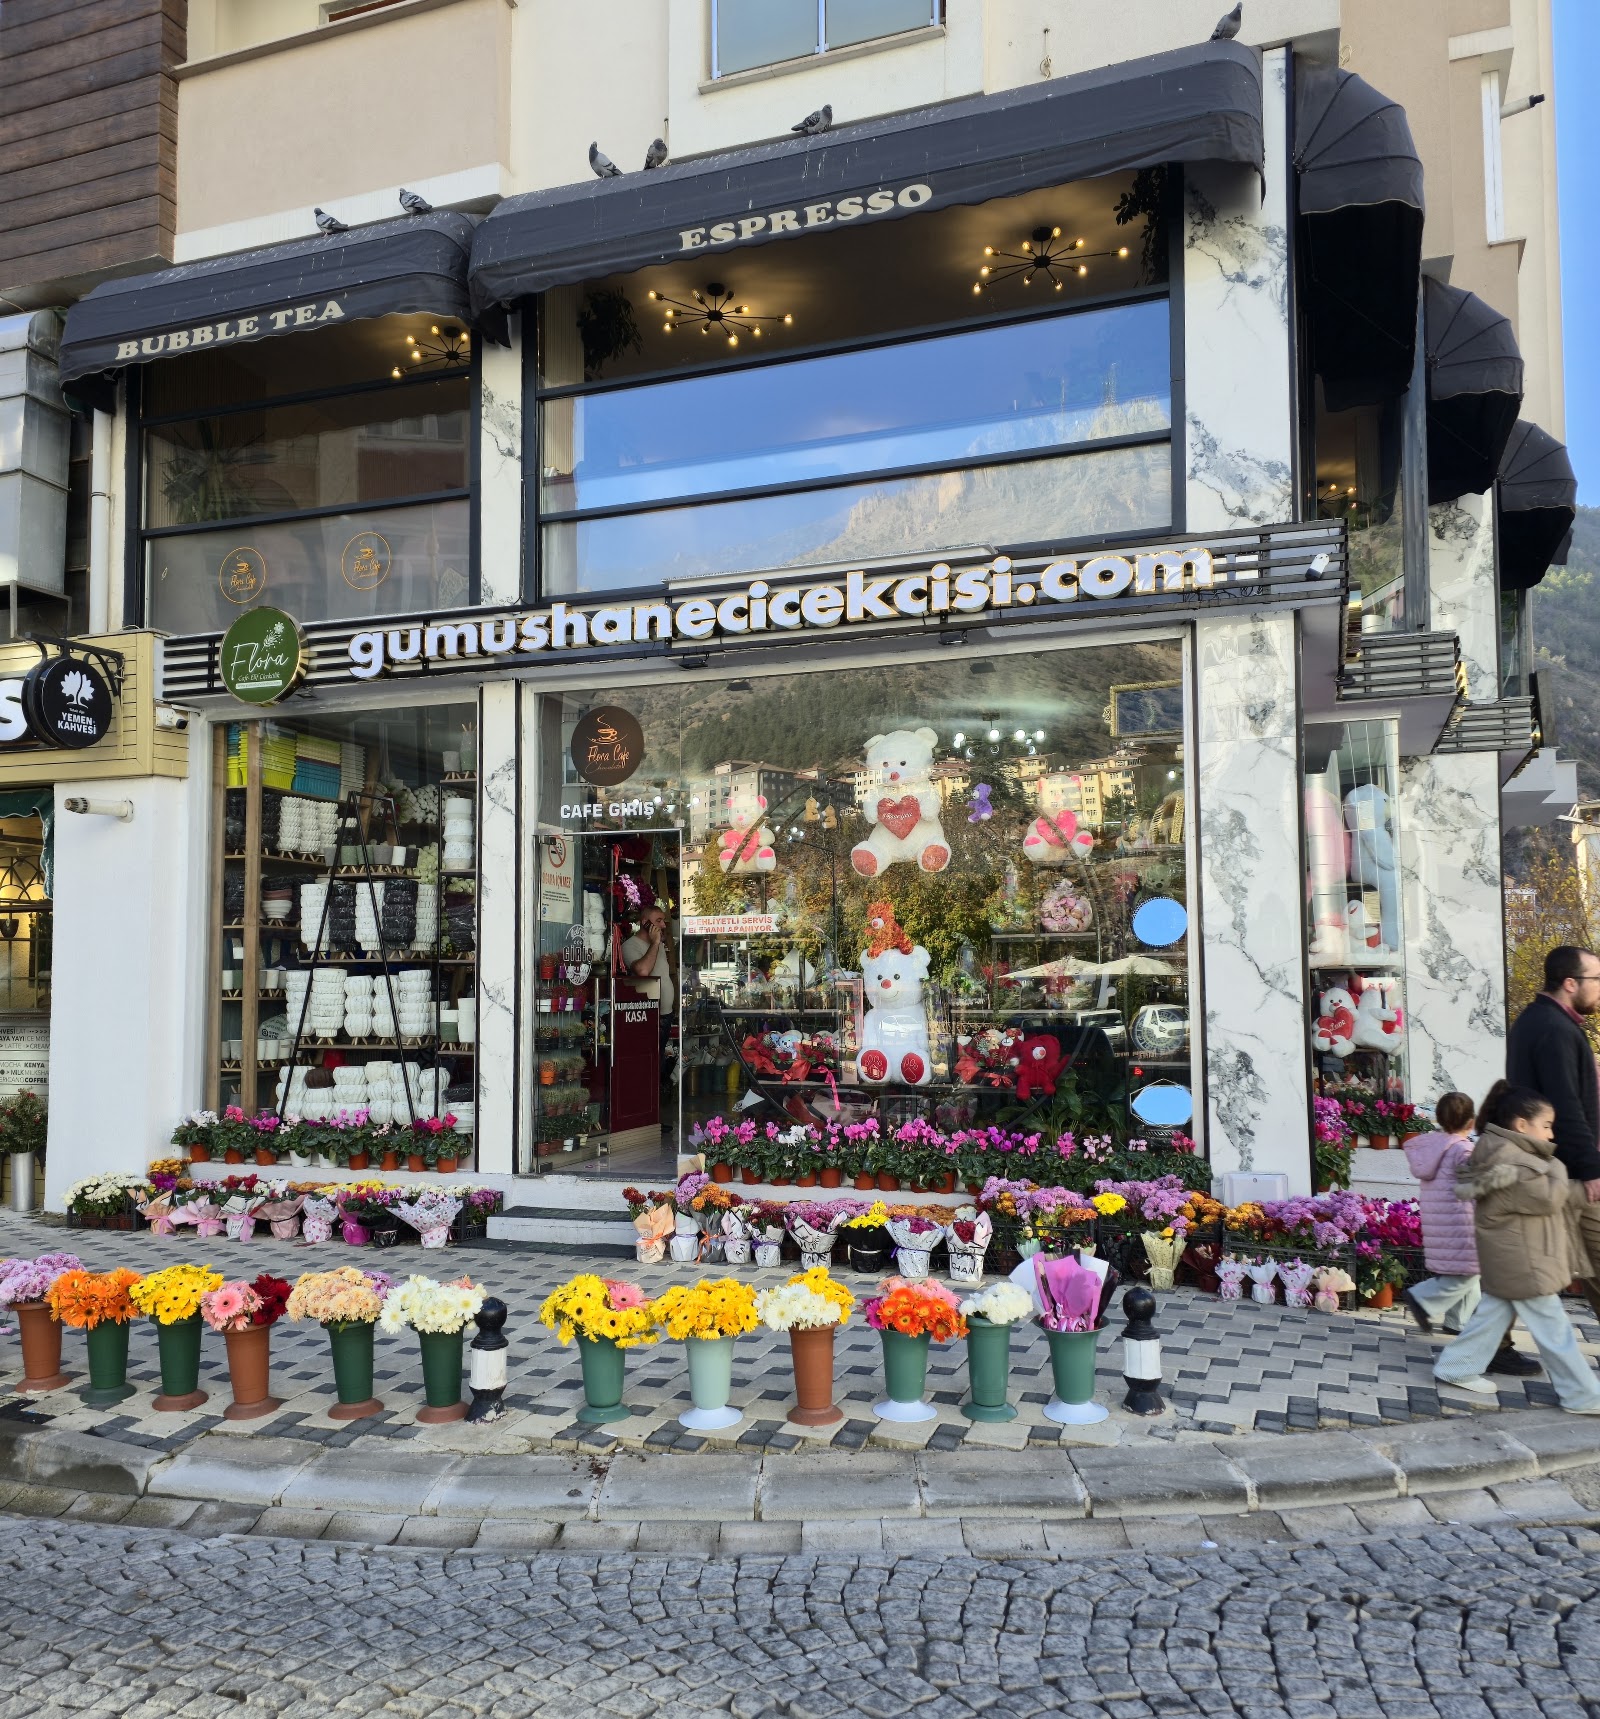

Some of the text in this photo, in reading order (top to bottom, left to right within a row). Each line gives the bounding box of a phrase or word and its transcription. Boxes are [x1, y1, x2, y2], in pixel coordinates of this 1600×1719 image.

[679, 183, 932, 251] ESPRESSO
[115, 300, 345, 360] BUBBLE TEA
[349, 547, 1214, 679] gumushanecicekcisi.com
[231, 642, 289, 680] Flora
[61, 711, 93, 726] YEMEN
[57, 720, 97, 735] KAHVESİ
[587, 745, 610, 763] Flora
[560, 803, 603, 819] CAFE
[741, 915, 773, 924] SERVİS
[625, 1010, 648, 1023] KASA
